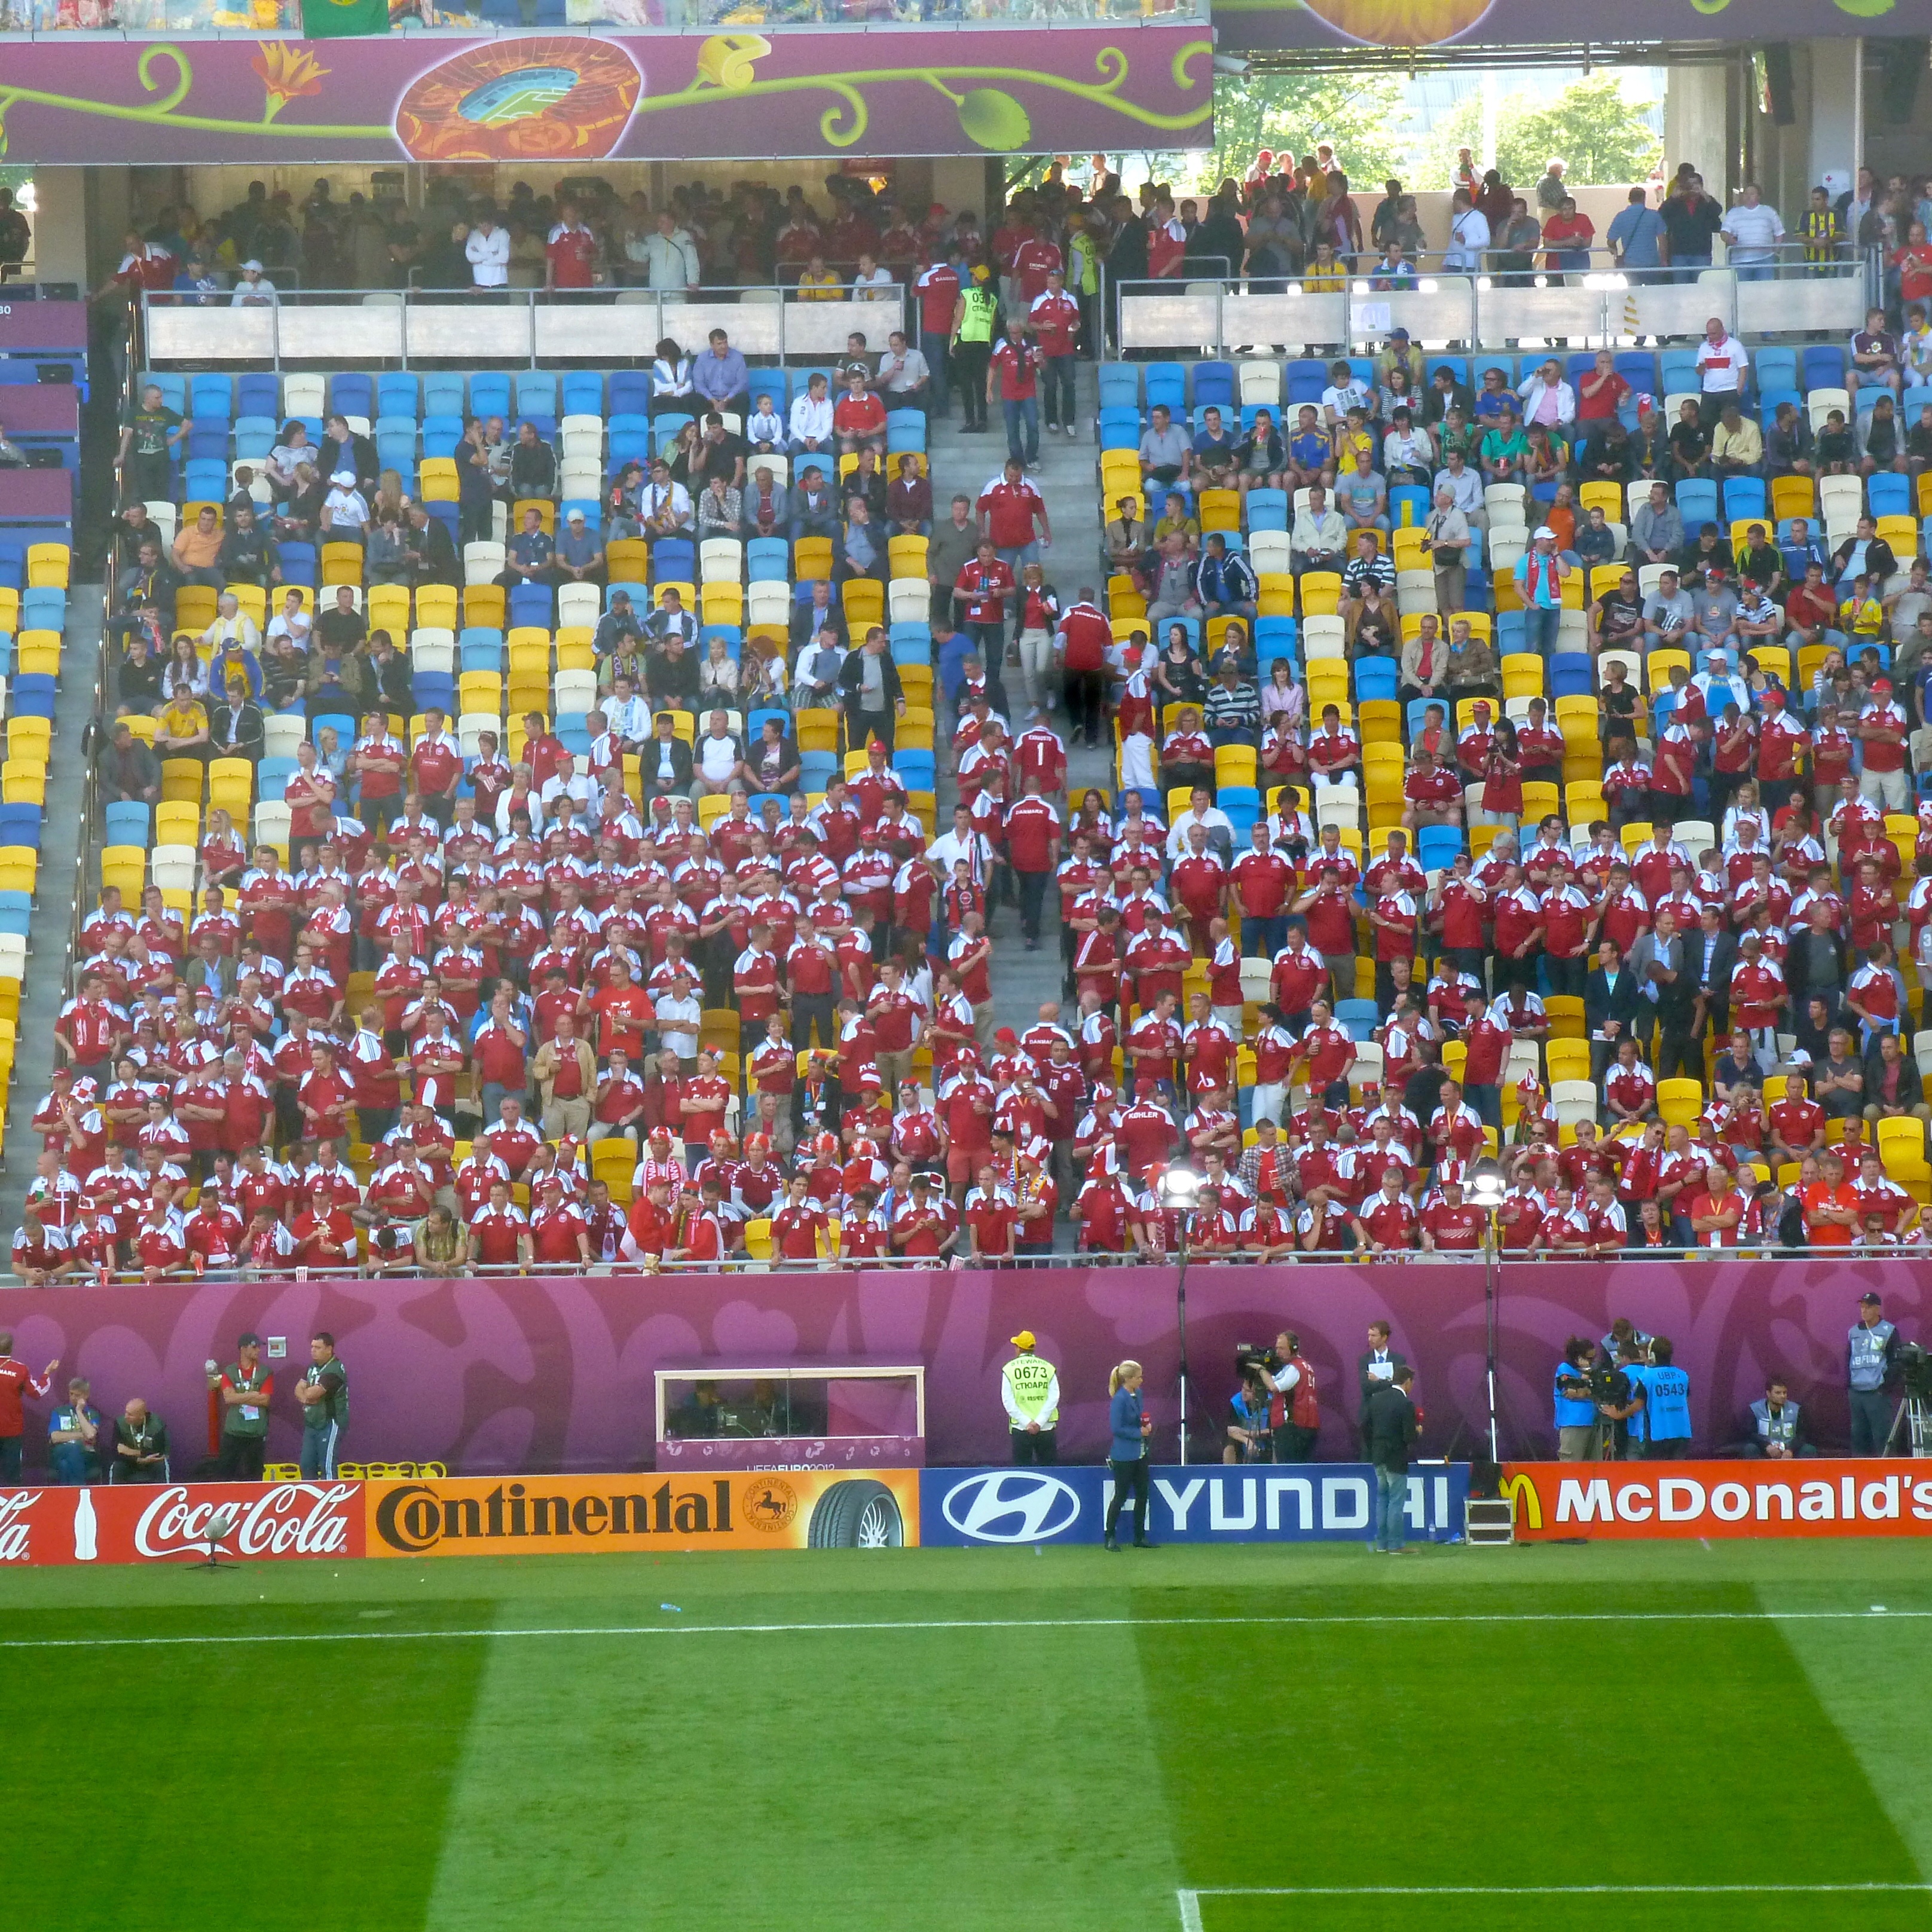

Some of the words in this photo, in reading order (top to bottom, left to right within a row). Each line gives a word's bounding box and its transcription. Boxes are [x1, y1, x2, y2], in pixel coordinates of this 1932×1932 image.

[1037, 742, 1044, 766] 1
[913, 1126, 921, 1137] 9
[1581, 1161, 1588, 1170] 5
[255, 1185, 264, 1196] 10
[404, 1183, 413, 1194] 10
[859, 1233, 866, 1243] 3
[1014, 1367, 1047, 1380] 0673
[1015, 1381, 1048, 1390] СТЮАРД
[1655, 1383, 1685, 1397] 0543
[1555, 1475, 1932, 1523] McDonald's
[134, 1483, 360, 1557] Coca-Cola
[375, 1479, 734, 1552] Continental
